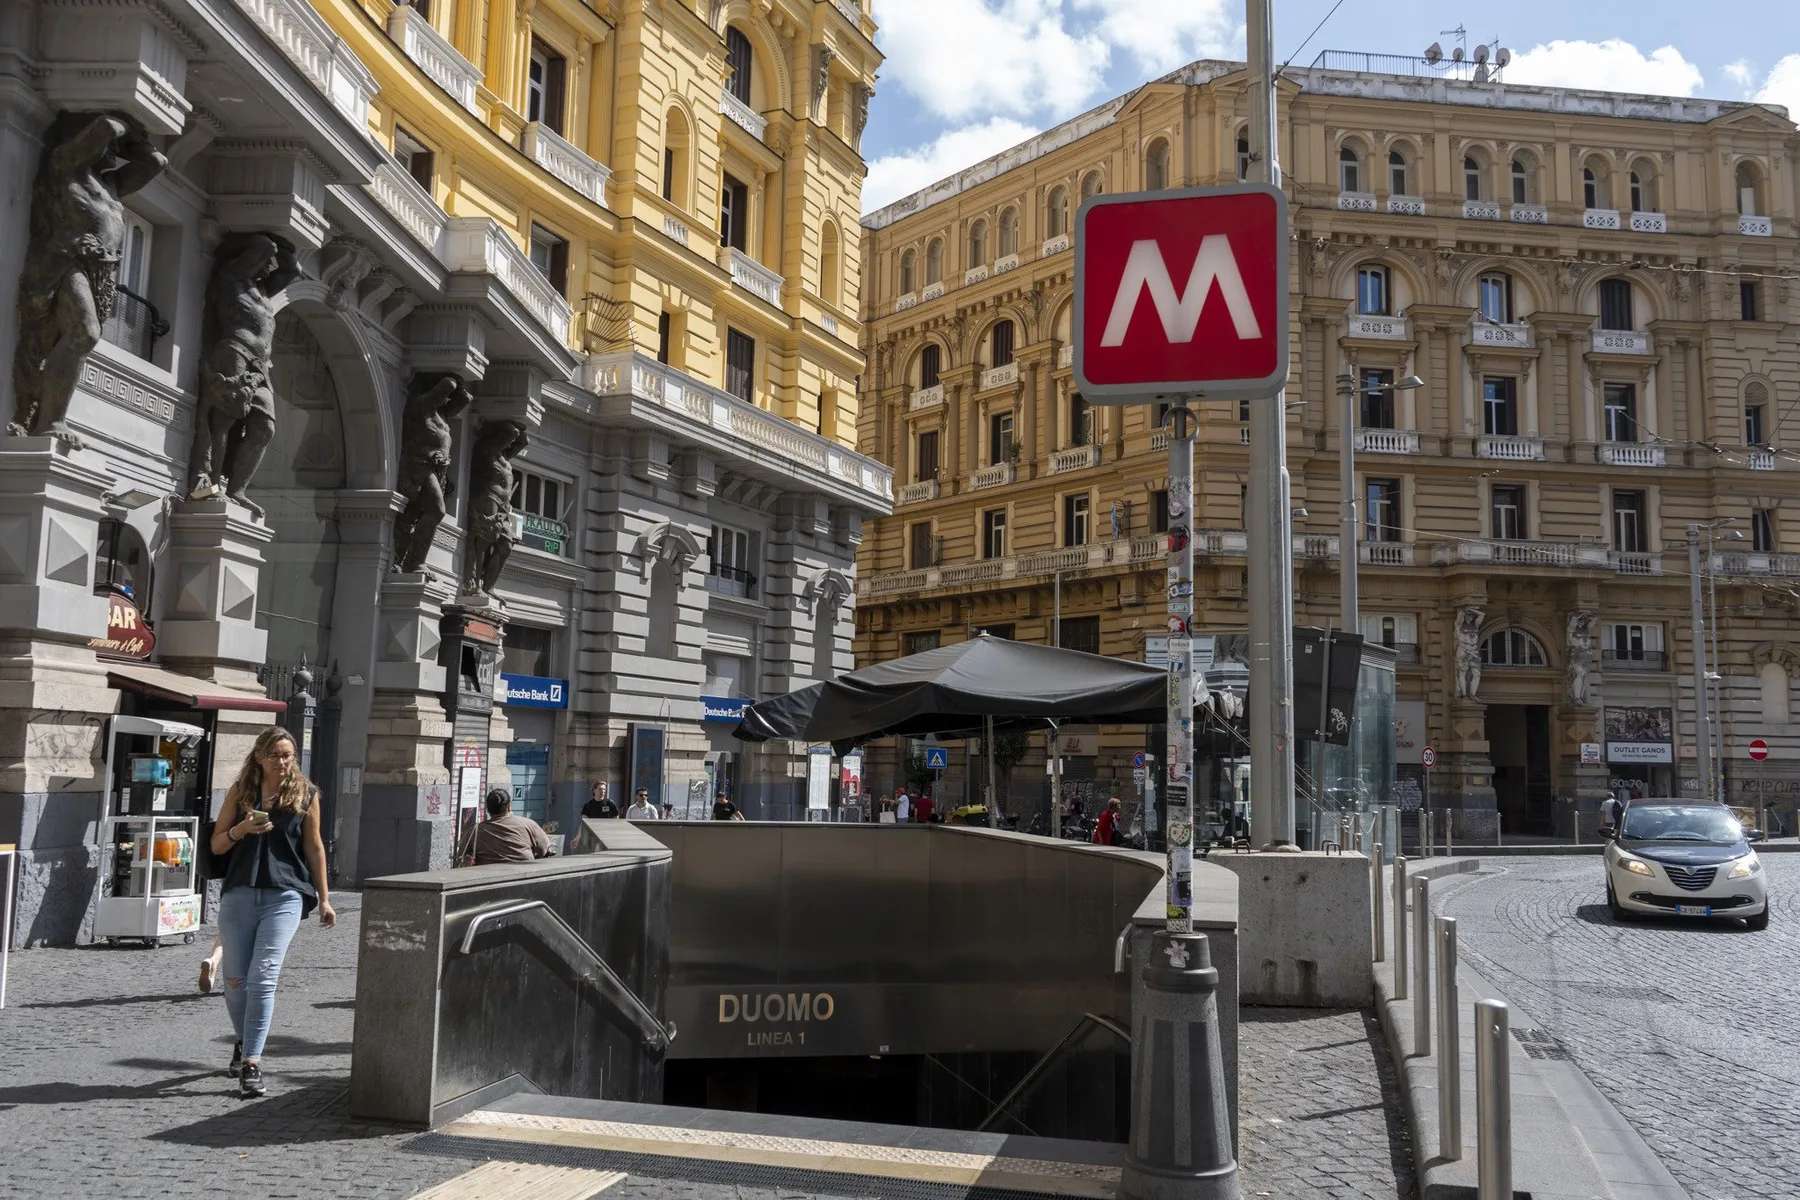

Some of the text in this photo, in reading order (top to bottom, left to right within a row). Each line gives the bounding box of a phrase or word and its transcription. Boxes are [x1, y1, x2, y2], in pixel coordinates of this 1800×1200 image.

[1100, 233, 1262, 347] M
[507, 688, 531, 700] utsche
[531, 689, 549, 702] Bank
[704, 706, 728, 717] Deutsche
[1613, 746, 1639, 754] OUTLET
[1425, 752, 1432, 762] 30
[719, 993, 834, 1022] DUOMO
[748, 1032, 805, 1045] LINEA 1
